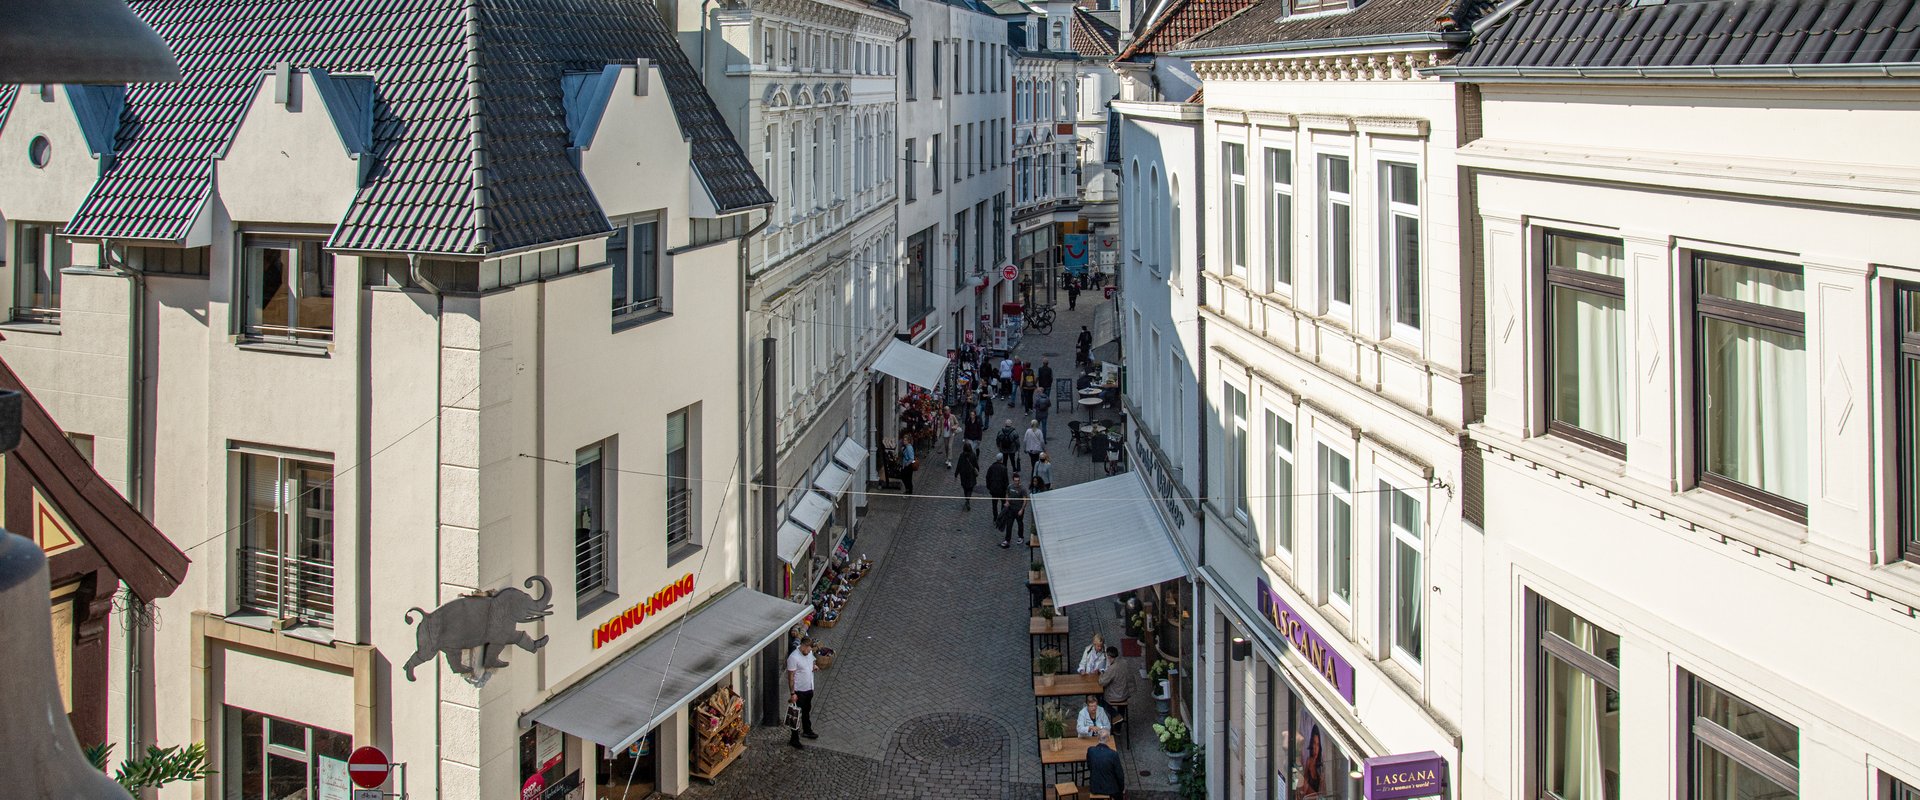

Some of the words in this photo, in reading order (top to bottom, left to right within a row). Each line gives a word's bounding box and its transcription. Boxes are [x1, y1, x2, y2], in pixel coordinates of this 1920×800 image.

[1263, 590, 1339, 690] LASCANA
[1376, 769, 1435, 785] LASCANA
[1415, 781, 1429, 789] world
